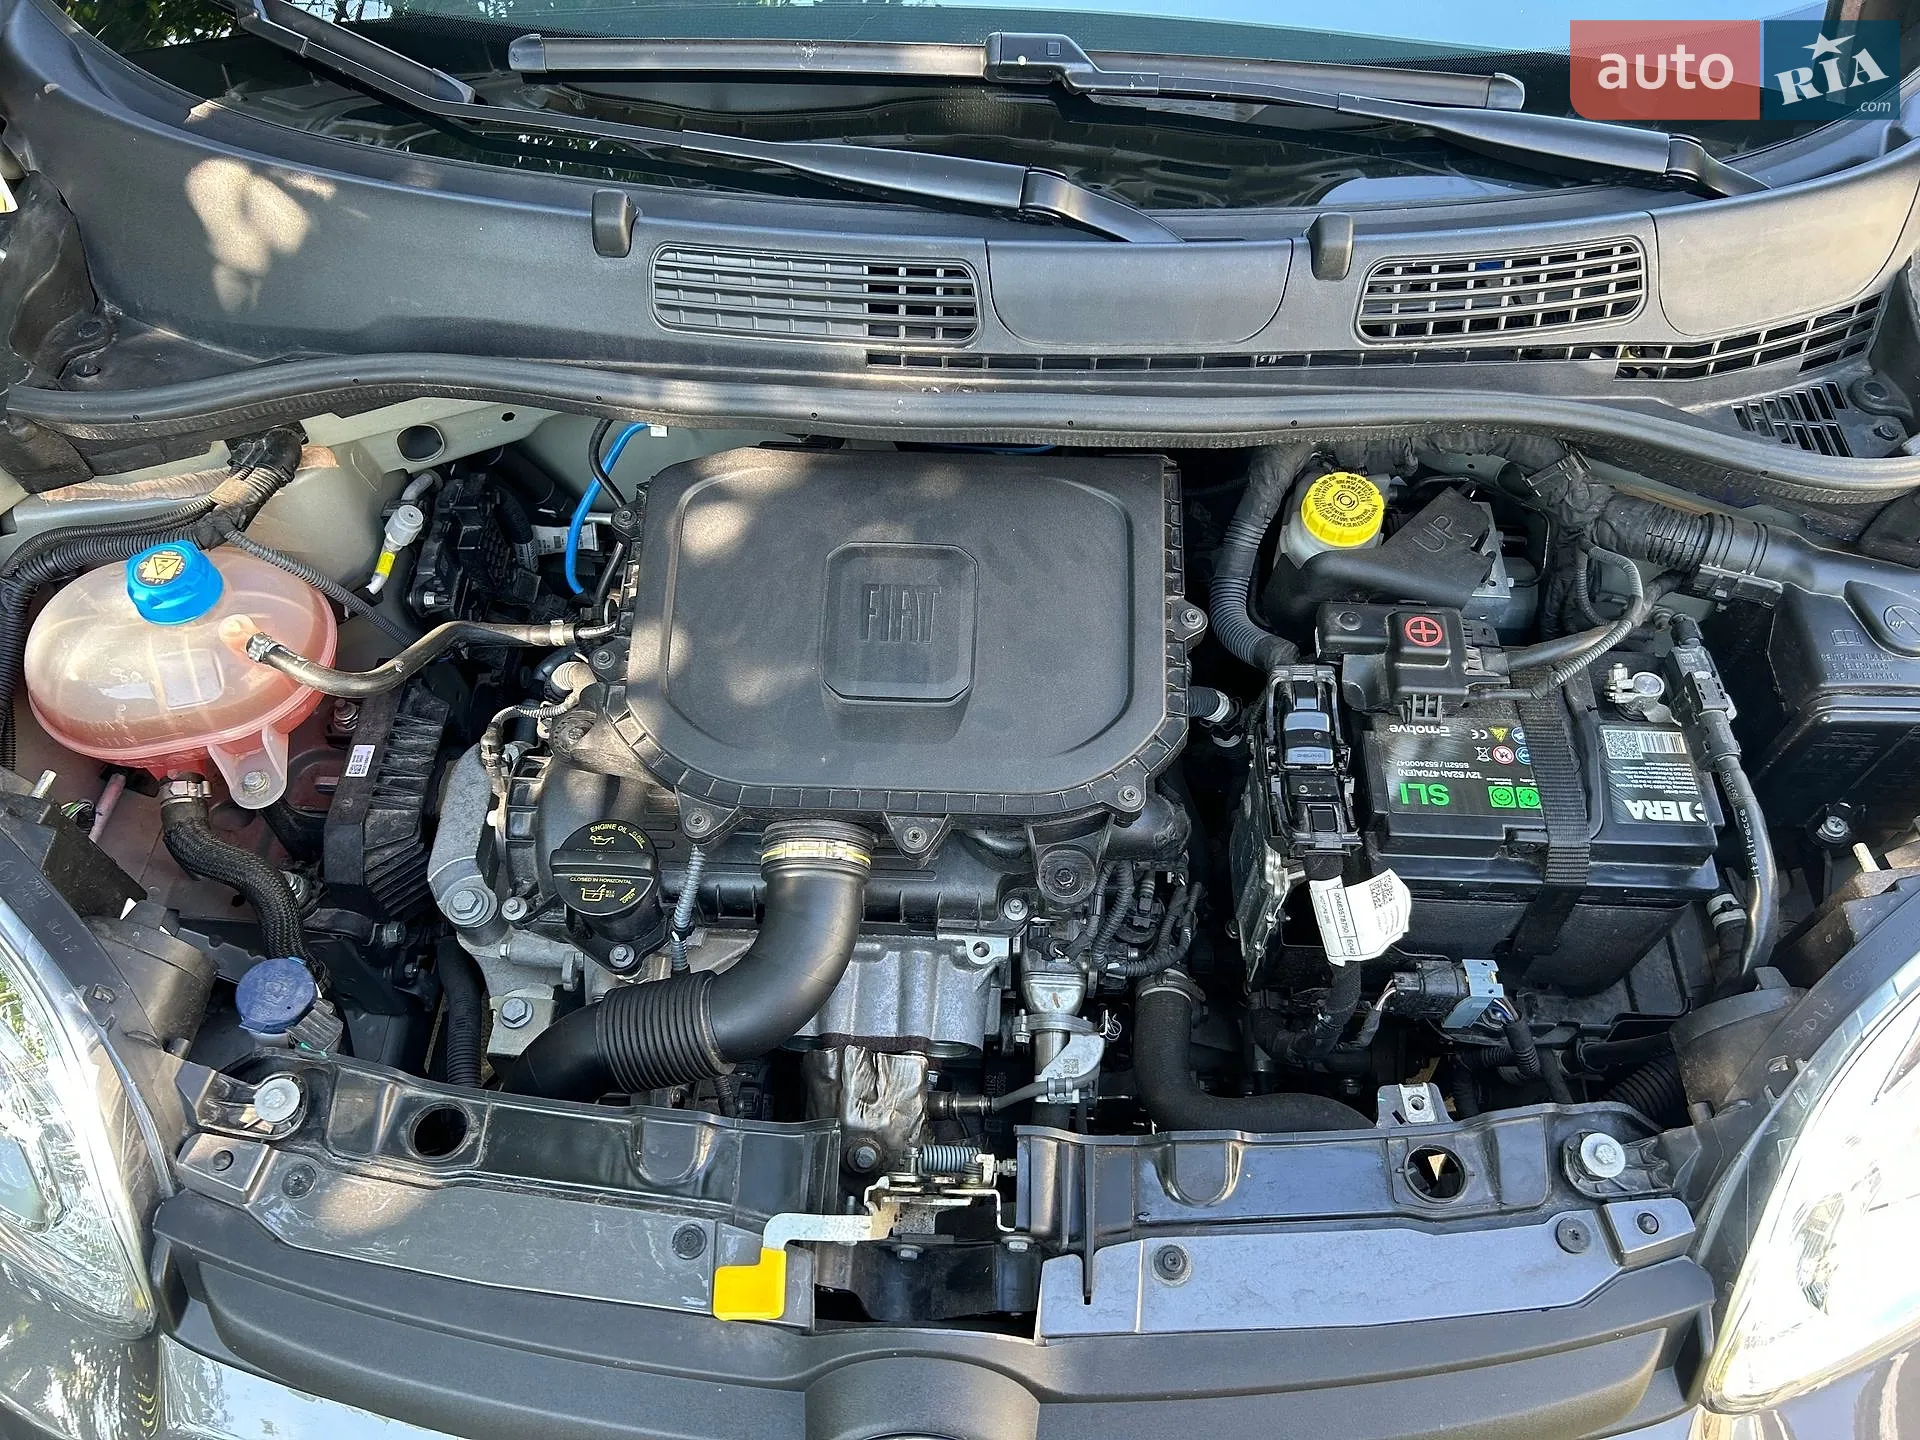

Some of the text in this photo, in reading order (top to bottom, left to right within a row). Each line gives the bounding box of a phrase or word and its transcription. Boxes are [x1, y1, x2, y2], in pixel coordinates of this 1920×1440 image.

[861, 583, 942, 643] FIAT
[1389, 724, 1451, 737] Emotive
[1465, 771, 1482, 779] 12V
[1399, 783, 1450, 806] SLI
[589, 823, 628, 834] ENGINE OIL
[1739, 808, 1761, 879] italtrecce
